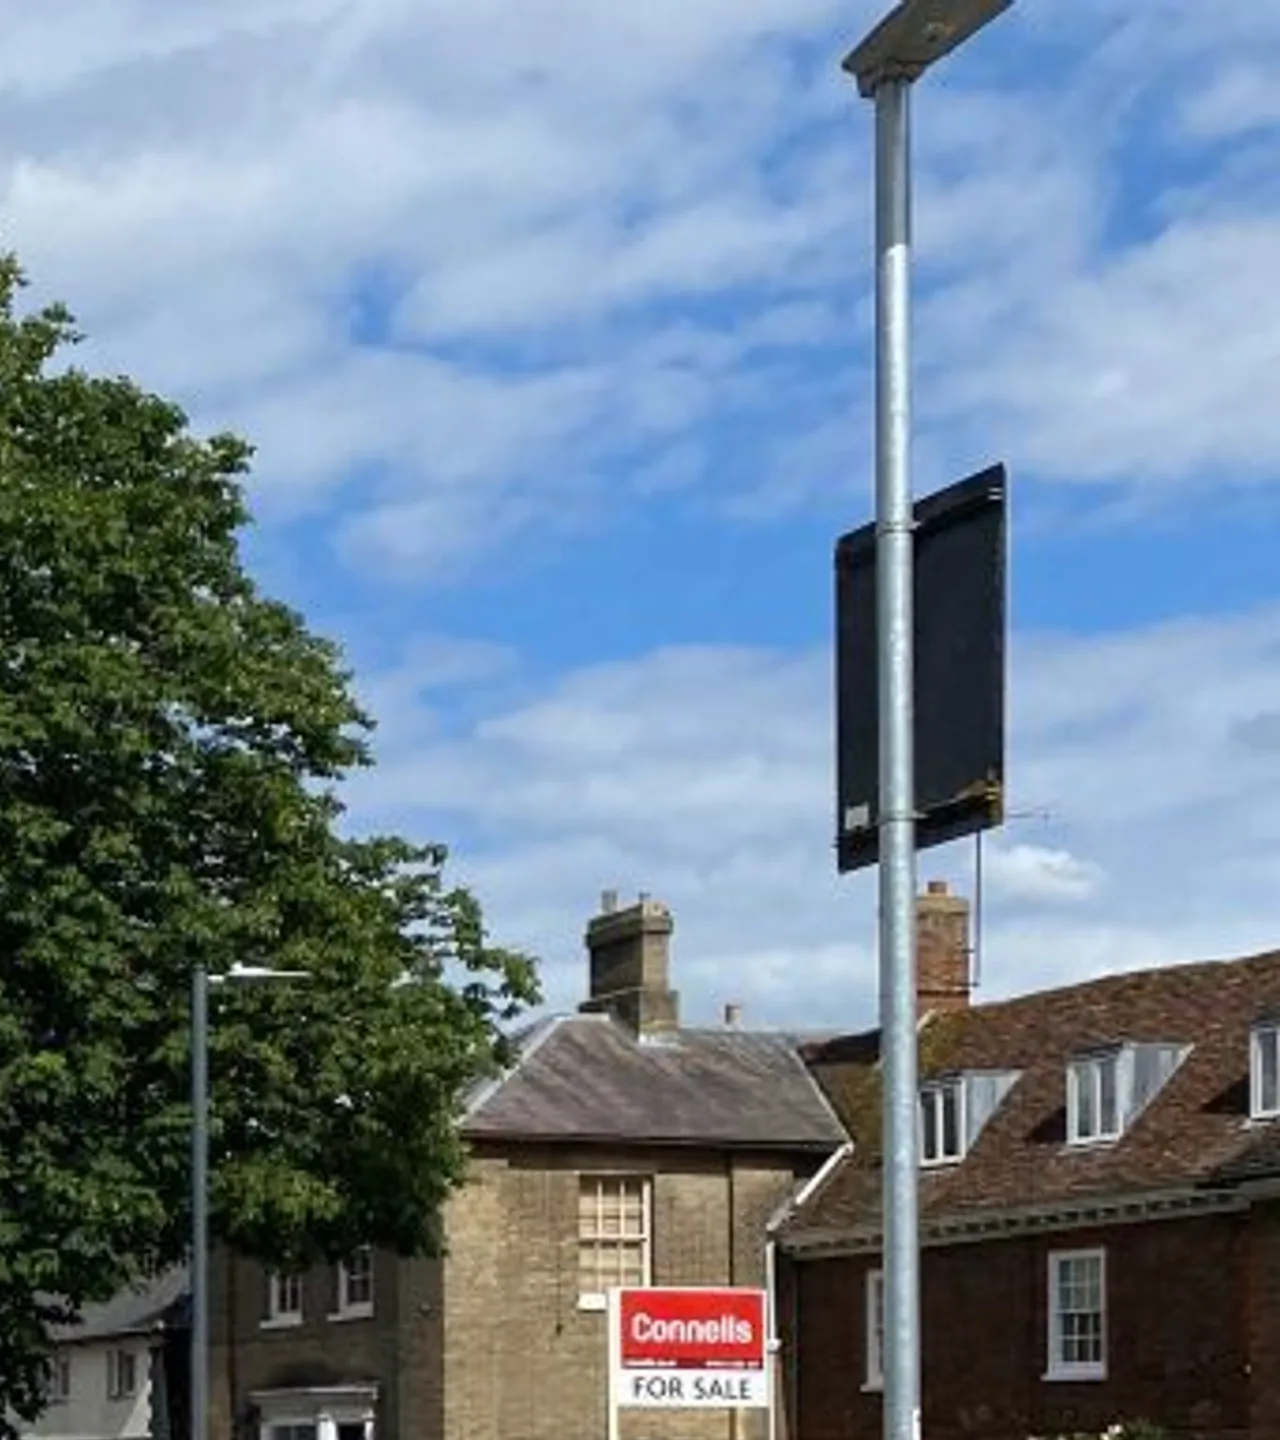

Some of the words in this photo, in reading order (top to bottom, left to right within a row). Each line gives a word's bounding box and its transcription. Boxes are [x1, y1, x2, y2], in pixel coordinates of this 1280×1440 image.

[631, 1312, 753, 1344] Connells
[633, 1376, 684, 1399] FOR
[694, 1377, 752, 1400] SALE
